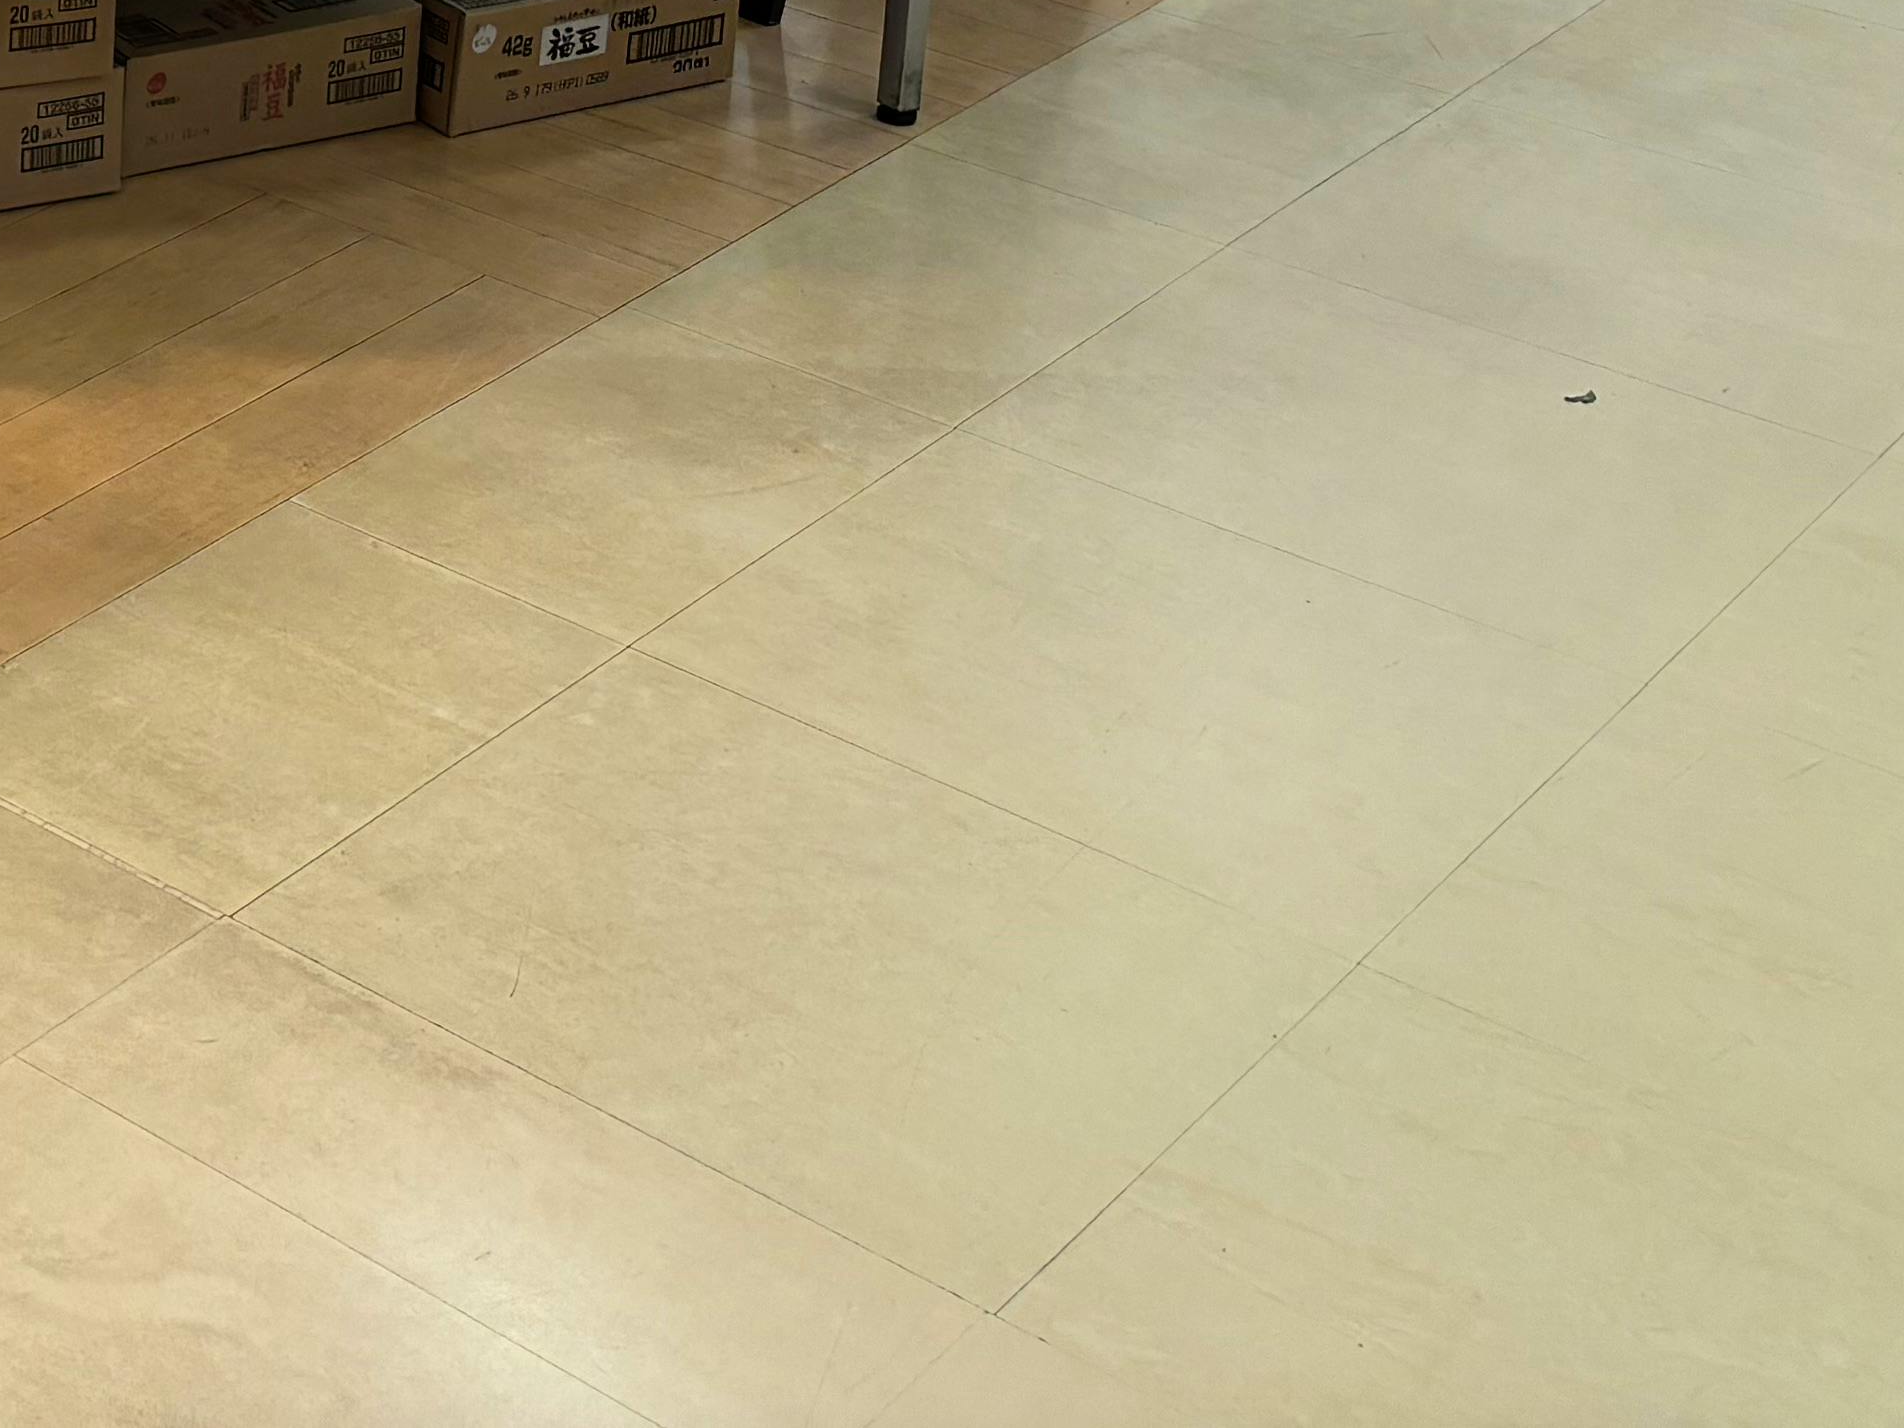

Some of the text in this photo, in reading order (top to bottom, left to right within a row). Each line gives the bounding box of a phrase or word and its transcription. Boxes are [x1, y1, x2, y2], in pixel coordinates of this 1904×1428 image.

[501, 4, 658, 62] 42g 福豆 (和紙)
